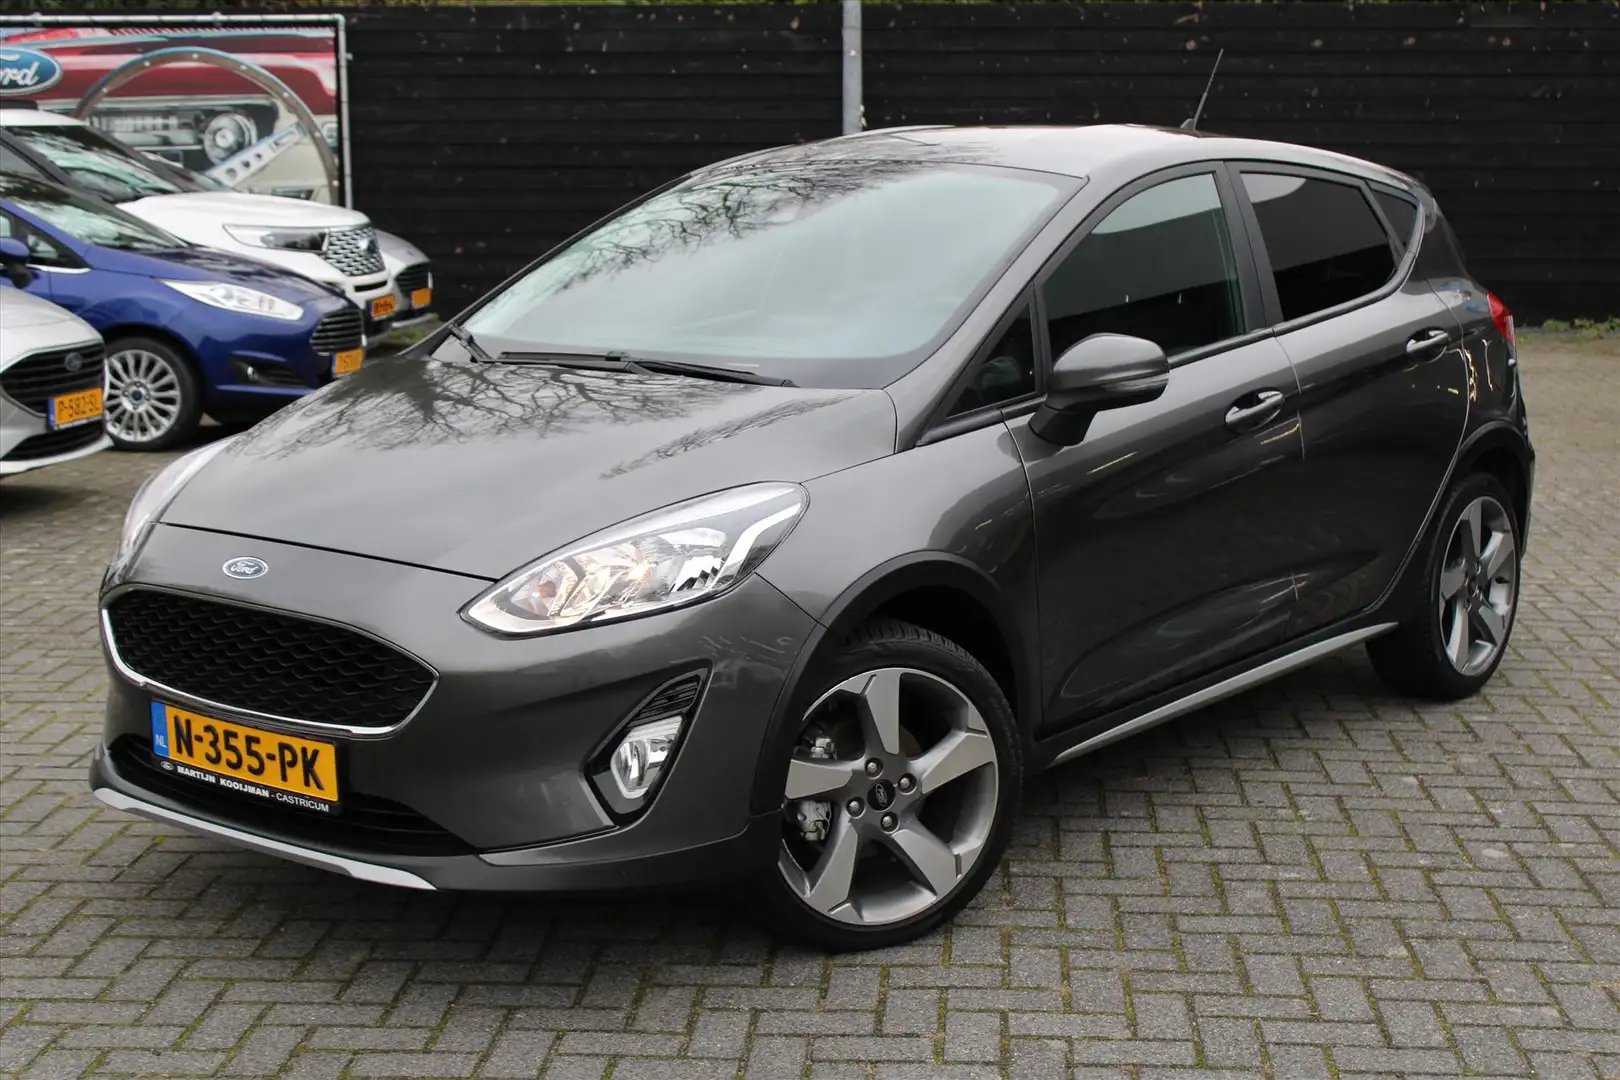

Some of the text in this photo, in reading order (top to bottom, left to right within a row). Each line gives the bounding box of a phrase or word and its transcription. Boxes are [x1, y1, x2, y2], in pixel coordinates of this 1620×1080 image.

[230, 560, 259, 575] Ford
[155, 734, 168, 749] NL
[173, 714, 325, 792] N-355-PK
[176, 765, 216, 784] MARTIJN
[219, 777, 270, 798] KOOIJMAN
[276, 792, 329, 813] CASTRICUM
